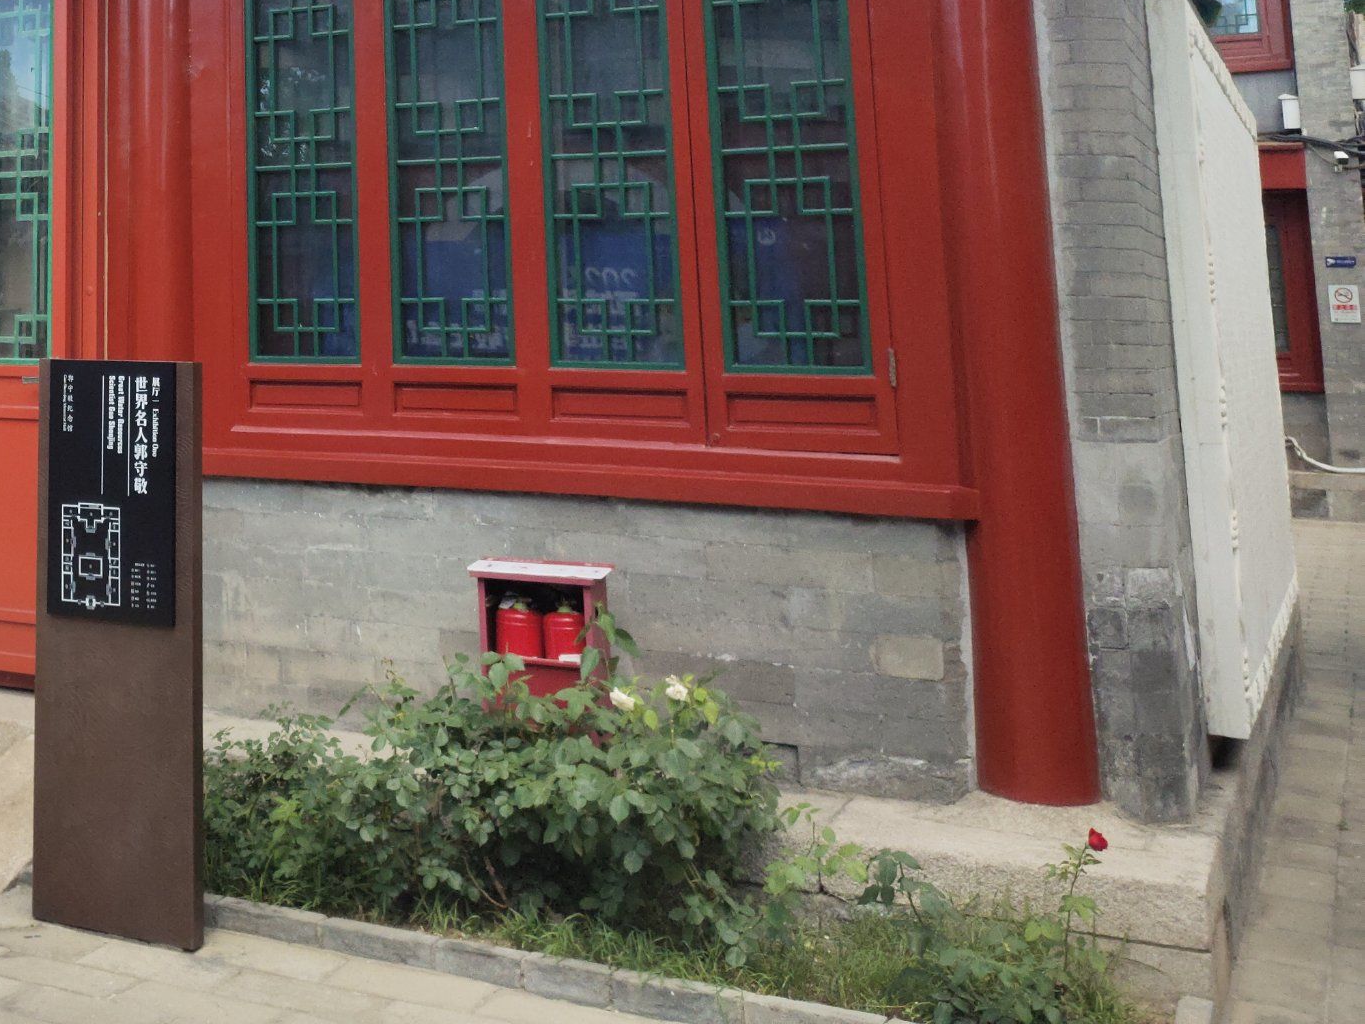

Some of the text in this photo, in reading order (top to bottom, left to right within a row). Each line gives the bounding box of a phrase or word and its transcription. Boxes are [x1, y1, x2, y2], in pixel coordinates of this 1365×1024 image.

[108, 376, 116, 405] Scientist
[117, 376, 125, 395] Great
[152, 377, 160, 403] 展厅一
[117, 396, 125, 417] Water
[134, 376, 148, 494] 世界名人郭守敬
